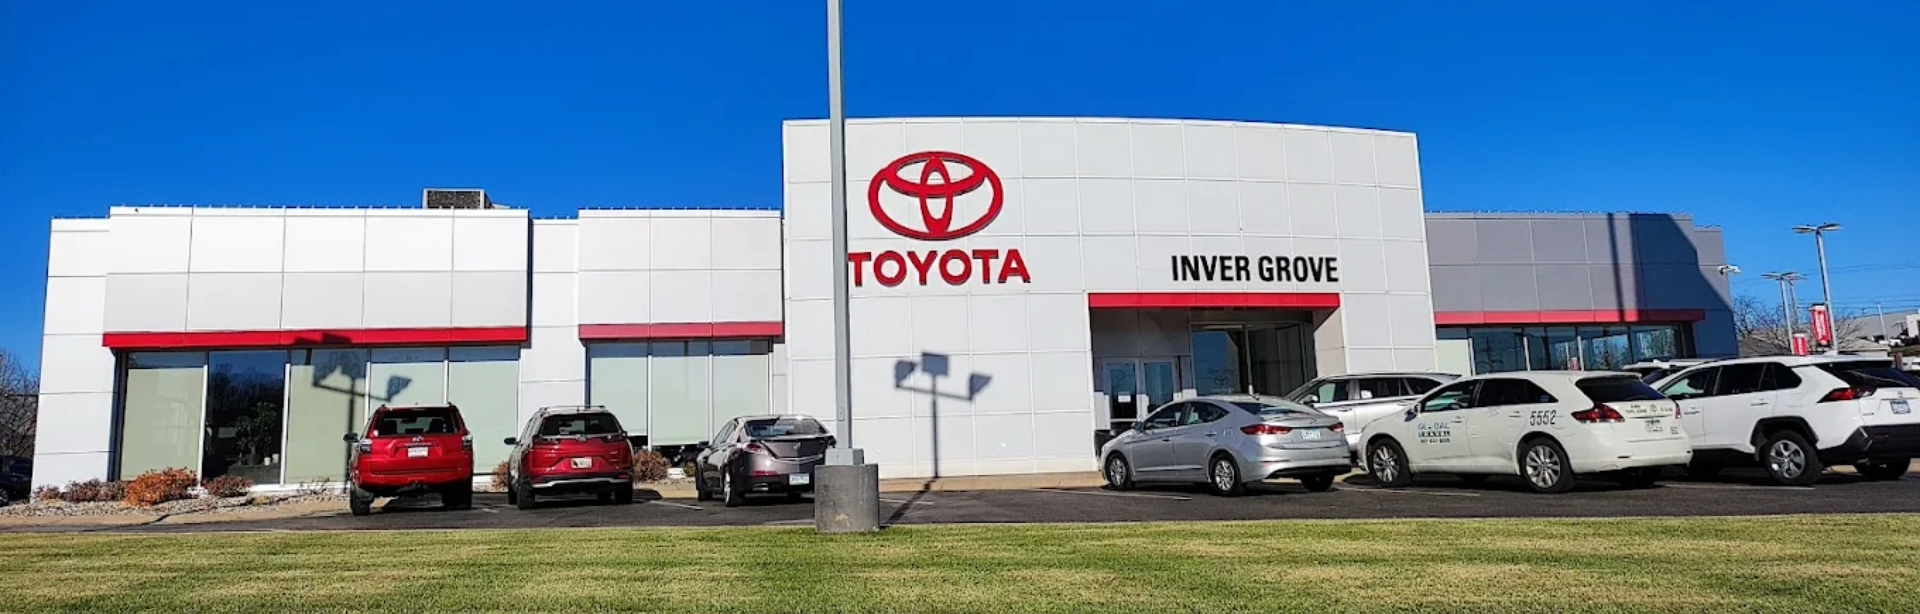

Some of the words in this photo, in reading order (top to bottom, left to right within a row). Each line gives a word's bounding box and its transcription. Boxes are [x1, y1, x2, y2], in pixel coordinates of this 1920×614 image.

[847, 249, 1031, 287] TOYOTA
[1171, 255, 1251, 281] INVER
[1257, 255, 1339, 282] GROVE
[1530, 410, 1557, 426] 5552
